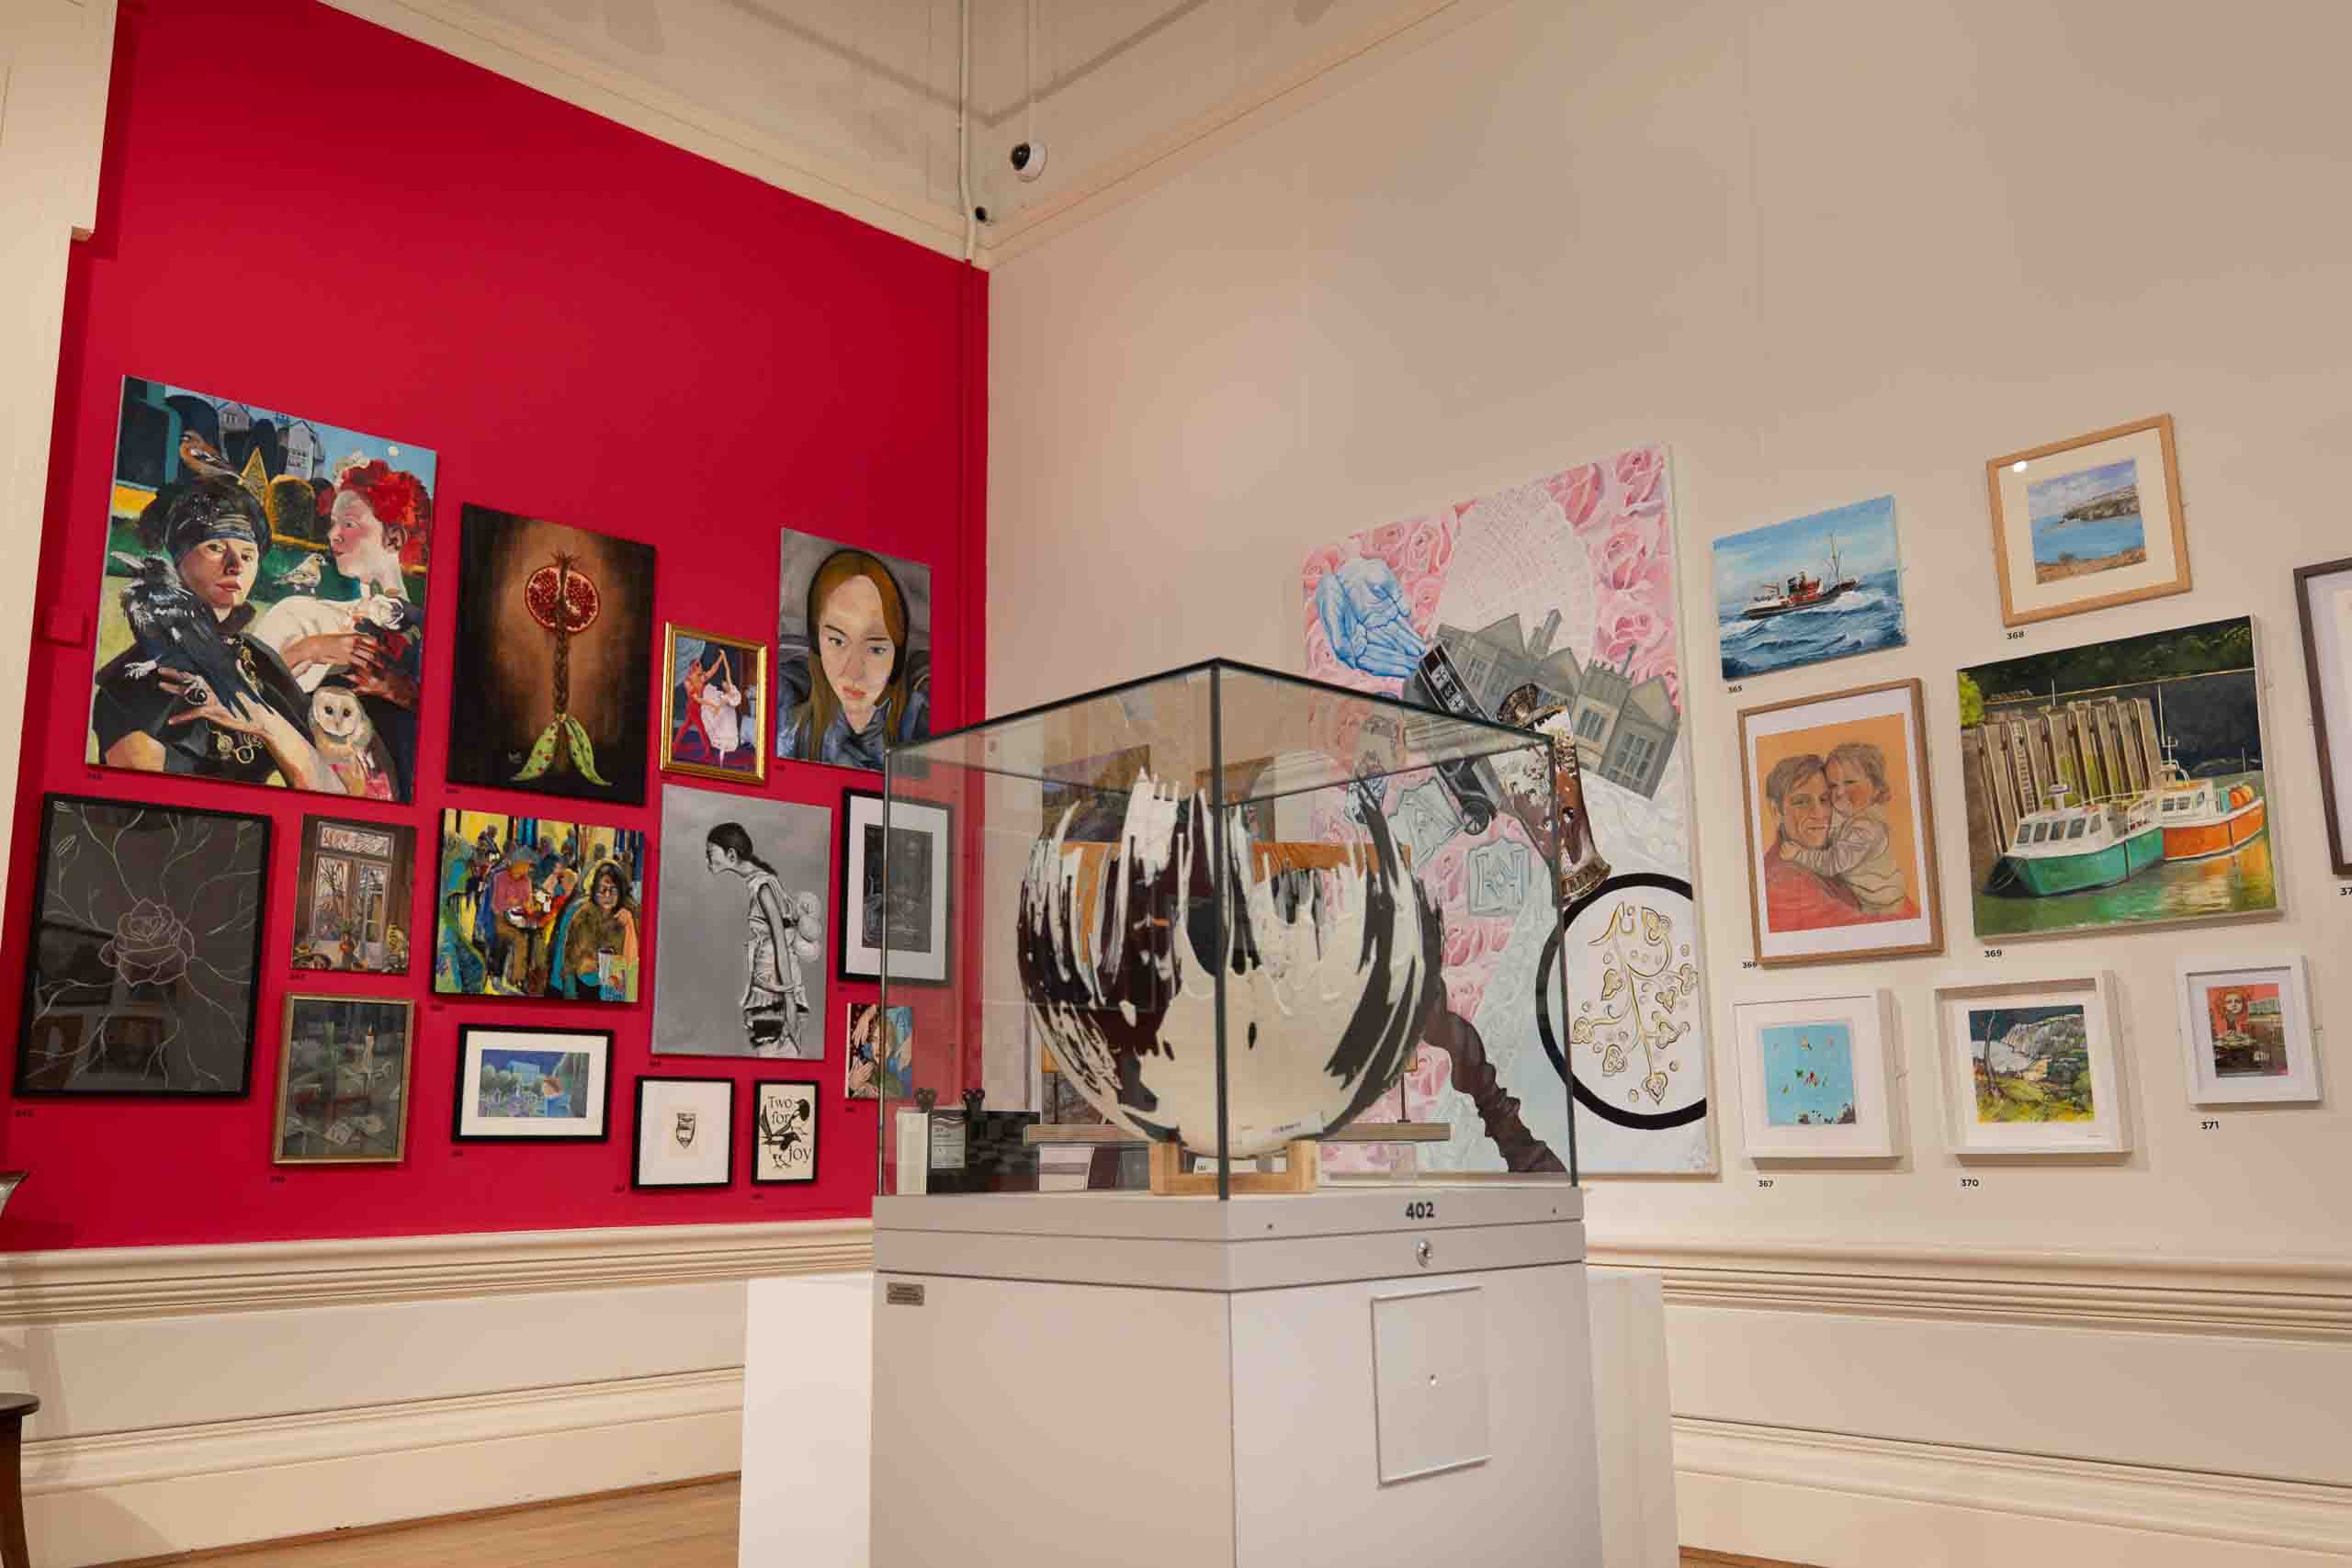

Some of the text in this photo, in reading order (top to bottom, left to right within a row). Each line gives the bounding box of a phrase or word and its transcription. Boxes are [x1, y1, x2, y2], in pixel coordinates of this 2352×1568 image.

[768, 1096, 793, 1109] Two
[772, 1111, 790, 1124] for
[2200, 1121, 2219, 1129] 371
[788, 1146, 811, 1163] joy
[1962, 1179, 1978, 1187] 370
[1406, 1202, 1434, 1219] 402
